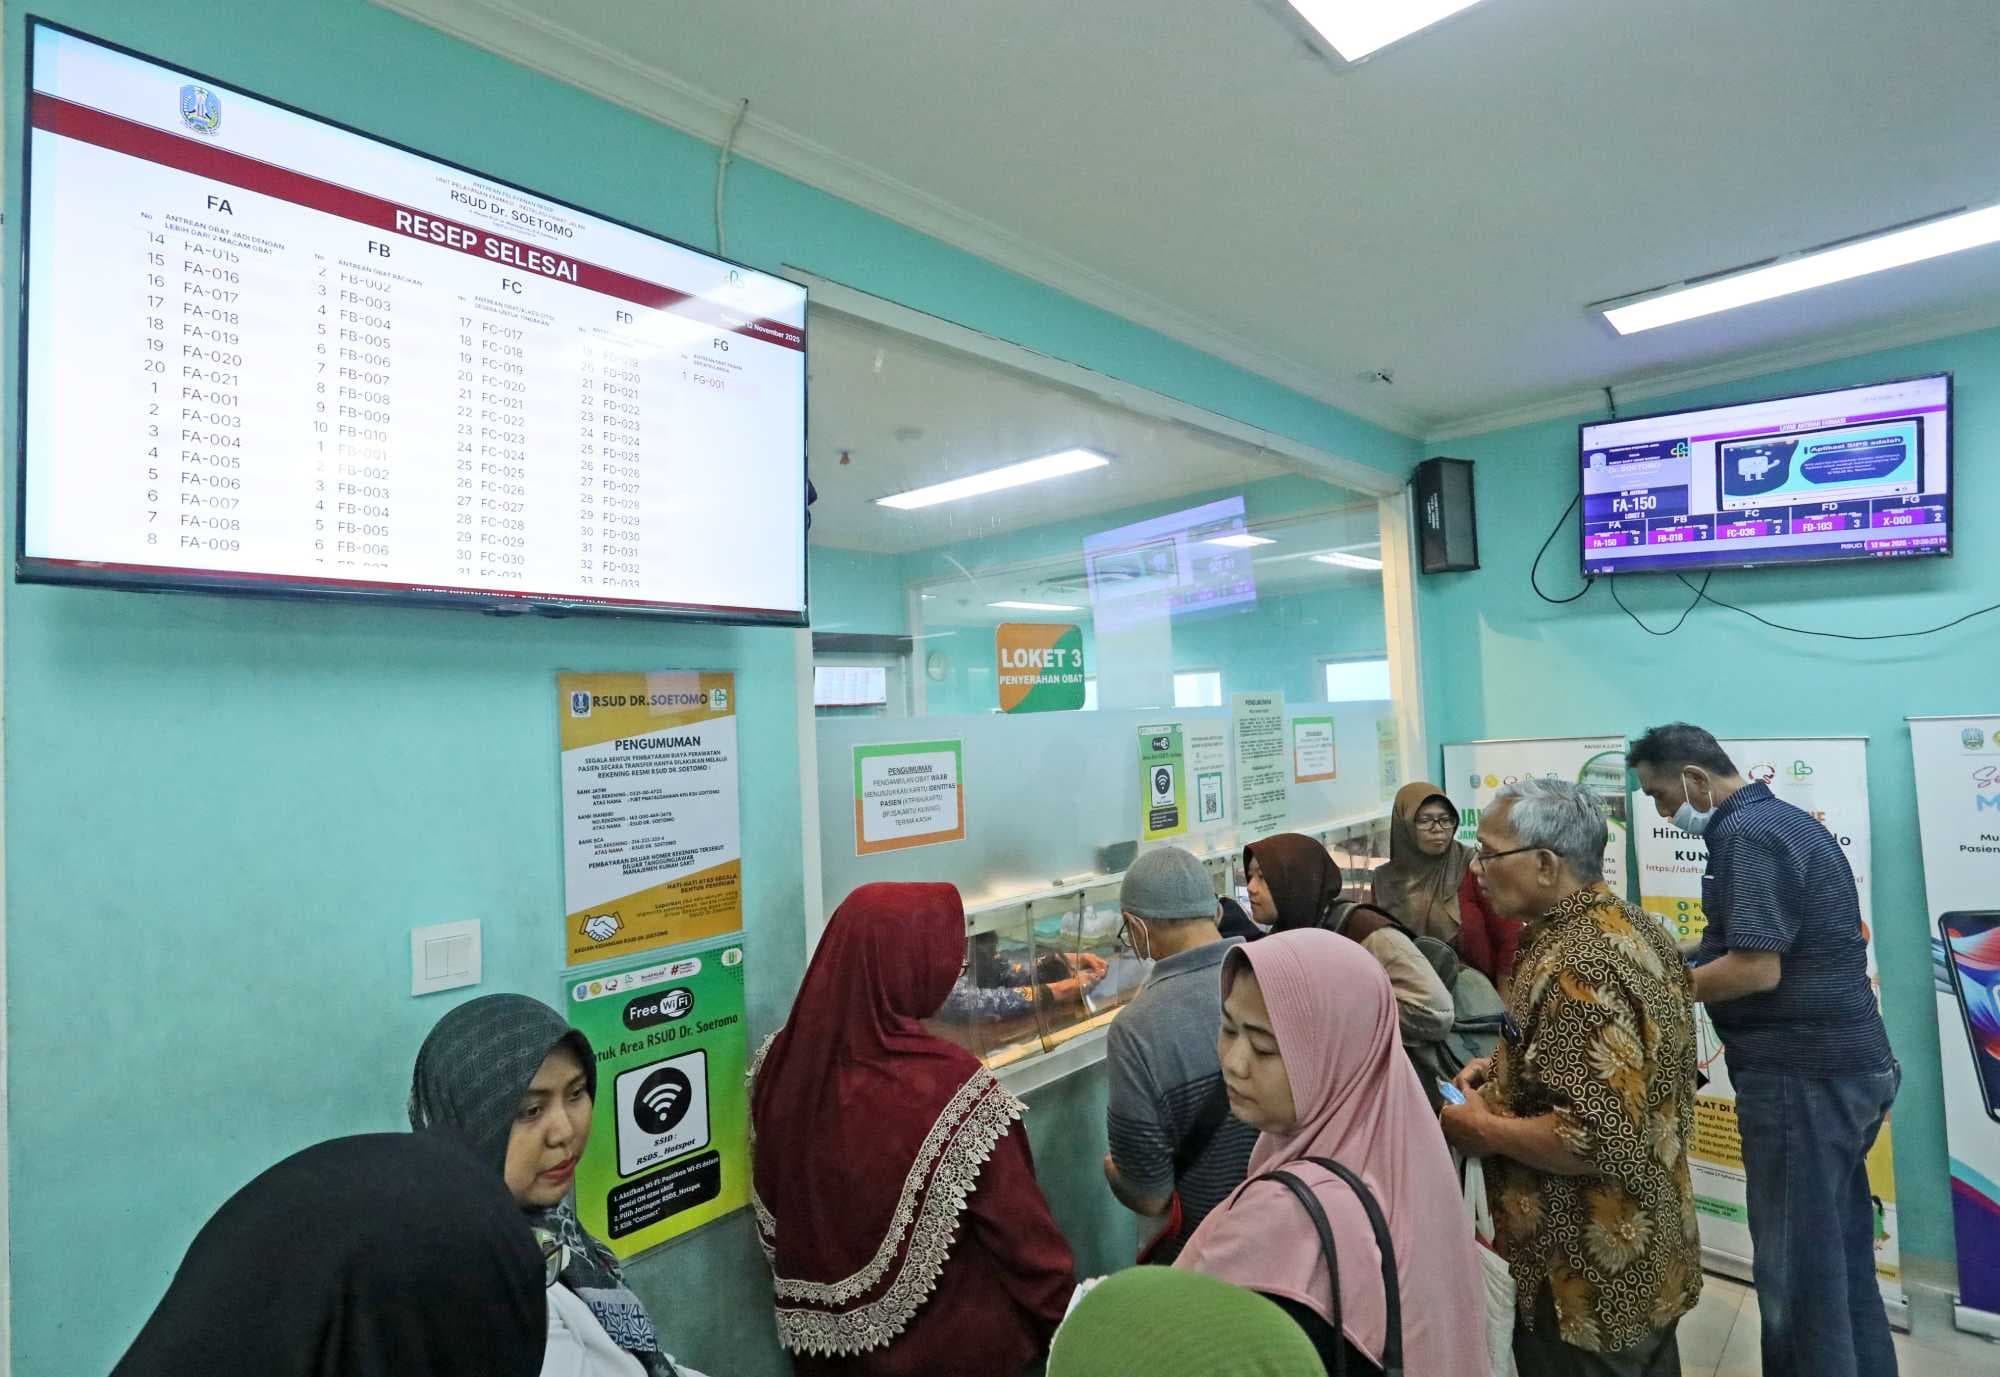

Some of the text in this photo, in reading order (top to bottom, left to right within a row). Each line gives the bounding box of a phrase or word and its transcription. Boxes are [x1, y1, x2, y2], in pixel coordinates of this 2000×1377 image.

[207, 195, 234, 216] FA
[451, 190, 486, 210] RSUD
[491, 203, 508, 218] Dr.
[511, 210, 574, 238] SOETOMO
[148, 232, 164, 244] 14
[396, 210, 477, 250] RESEP
[484, 238, 578, 282] SELESAI
[368, 240, 391, 258] FB
[148, 252, 239, 283] 15 FA-016
[148, 274, 238, 303] 16 FA-017
[502, 278, 523, 295] FC
[318, 285, 390, 311] 3 FB-003
[148, 295, 238, 324] 17 FA-018
[318, 305, 391, 333] 4 FB-004
[616, 310, 633, 324] FD
[147, 316, 238, 344] 18 FA-019
[318, 323, 390, 349] 5 FB-005
[460, 317, 523, 340] 17 FC-017
[754, 324, 784, 338] November
[147, 338, 242, 366] 19 FA-020
[460, 335, 523, 358] 18 FC-018
[714, 338, 729, 351] FG
[317, 344, 390, 367] 6 FB-006
[144, 360, 237, 386] 20 FA-021
[318, 362, 390, 386] 7 FB-007
[458, 370, 526, 392] 20 FC-020
[693, 374, 725, 391] FG-001
[152, 382, 237, 406] 1 FA-001
[317, 382, 390, 405] 8 FB-008
[582, 378, 637, 400] 21 FD-021
[149, 403, 240, 427] 2 FA-003
[316, 401, 390, 424] 9 FB-009
[458, 406, 524, 427] 22 FC-022
[581, 411, 640, 431] 23 FD-023
[149, 425, 240, 448] 3 FA-004
[458, 424, 525, 444] 23 FC-023
[581, 427, 639, 446] 24 FD-024
[148, 447, 240, 468] 4 FA-005
[458, 442, 525, 461] 24 FC-024
[149, 468, 240, 489] 5 FA-006
[581, 476, 639, 493] 27 FD-027
[148, 489, 239, 509] 6 FA-007
[1613, 496, 1656, 512] FA-150
[1822, 503, 1838, 511] FD
[1902, 495, 1920, 504] FG
[148, 511, 240, 530] 7 FA-008
[1608, 521, 1621, 529] FA
[1674, 515, 1687, 523] FB
[1854, 520, 1860, 528] 3
[1883, 516, 1912, 526] X-000
[1934, 513, 1941, 521] 2
[1701, 532, 1707, 540] 3
[1775, 526, 1781, 534] 2
[1802, 522, 1833, 532] FD-103
[147, 533, 239, 551] 8 FA-009
[1593, 539, 1617, 547] FA-150
[581, 560, 639, 574] 32 FD-032
[1002, 648, 1082, 668] LOKET 3
[1000, 674, 1082, 685] PENYERAHAN OBAT
[592, 694, 707, 707] RSUD DR.SOETOMO
[615, 736, 701, 751] PENGUMUMAN
[888, 765, 932, 776] PENGUMUMAN
[1653, 828, 1704, 840] Hinda
[630, 1004, 658, 1020] Free
[620, 1014, 738, 1056] Area RSUD Dr. Soetomo
[654, 1135, 673, 1146] SSID
